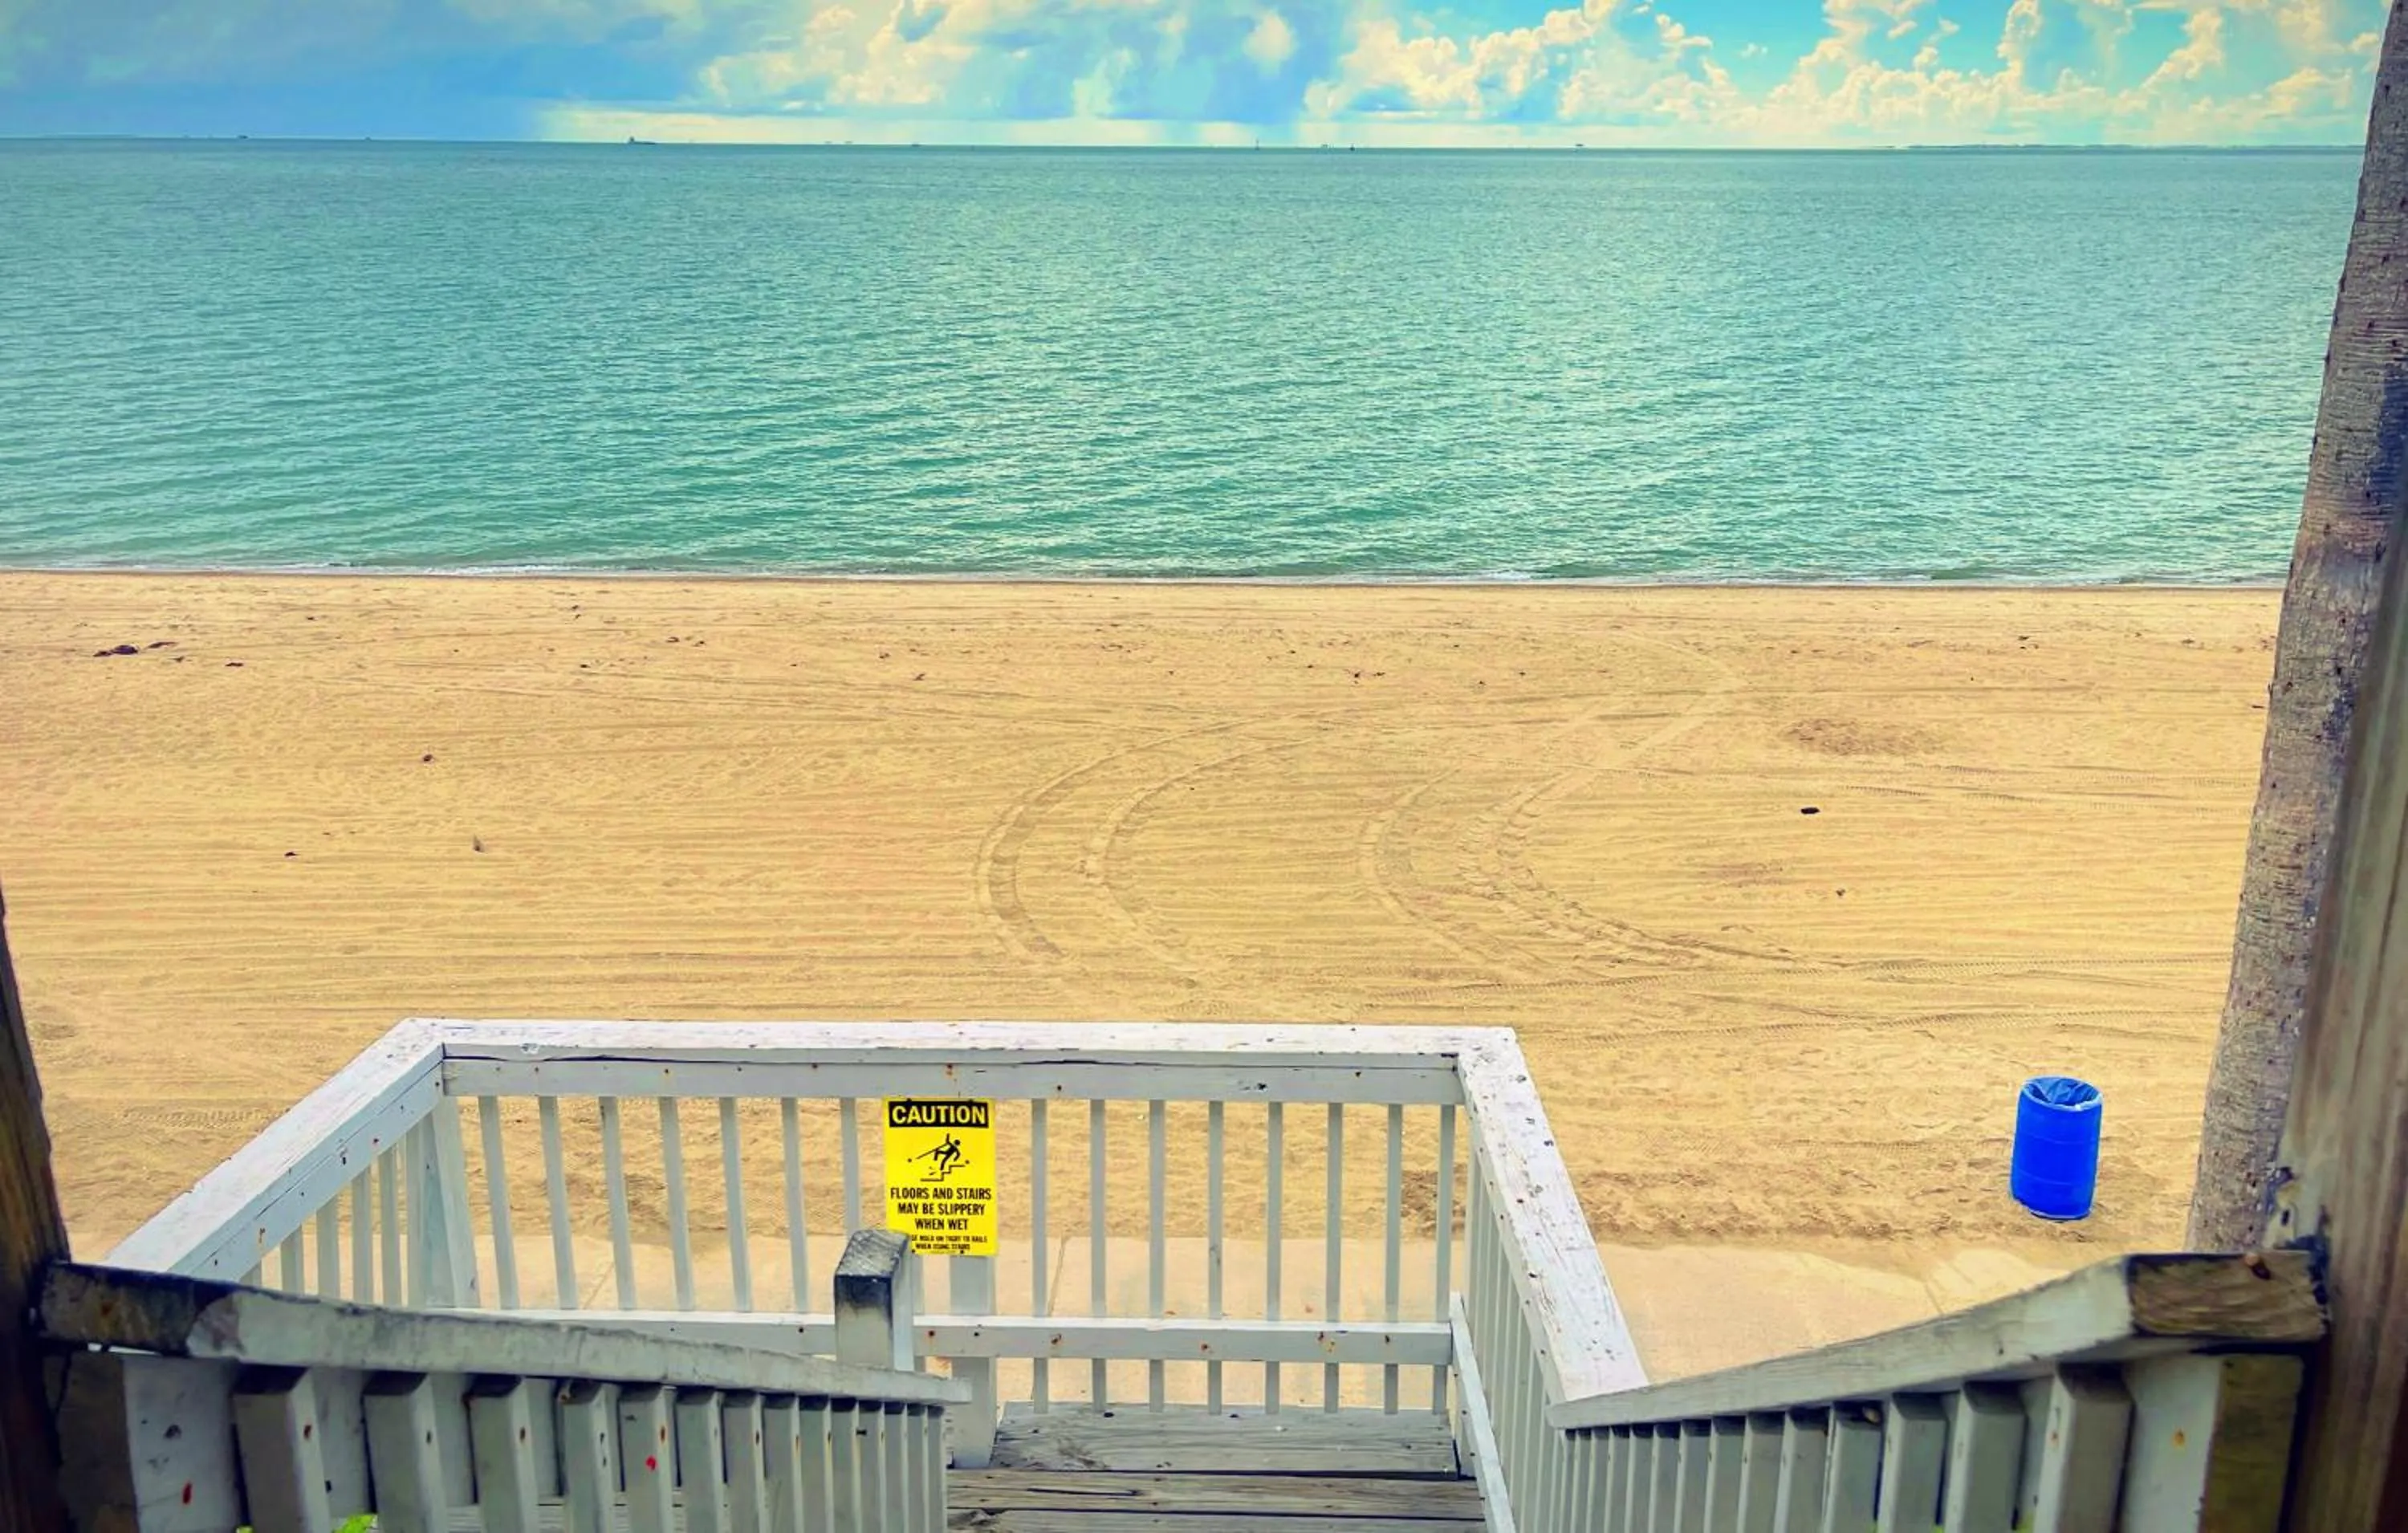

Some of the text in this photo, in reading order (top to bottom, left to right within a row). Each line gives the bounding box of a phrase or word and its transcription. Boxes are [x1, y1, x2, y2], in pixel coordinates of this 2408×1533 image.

[892, 1105, 986, 1124] CAUTION
[890, 1188, 991, 1200] FLOORS AND STAIRS
[897, 1203, 985, 1215] MAY BE SLIPPERY
[915, 1218, 968, 1230] WHEN WET
